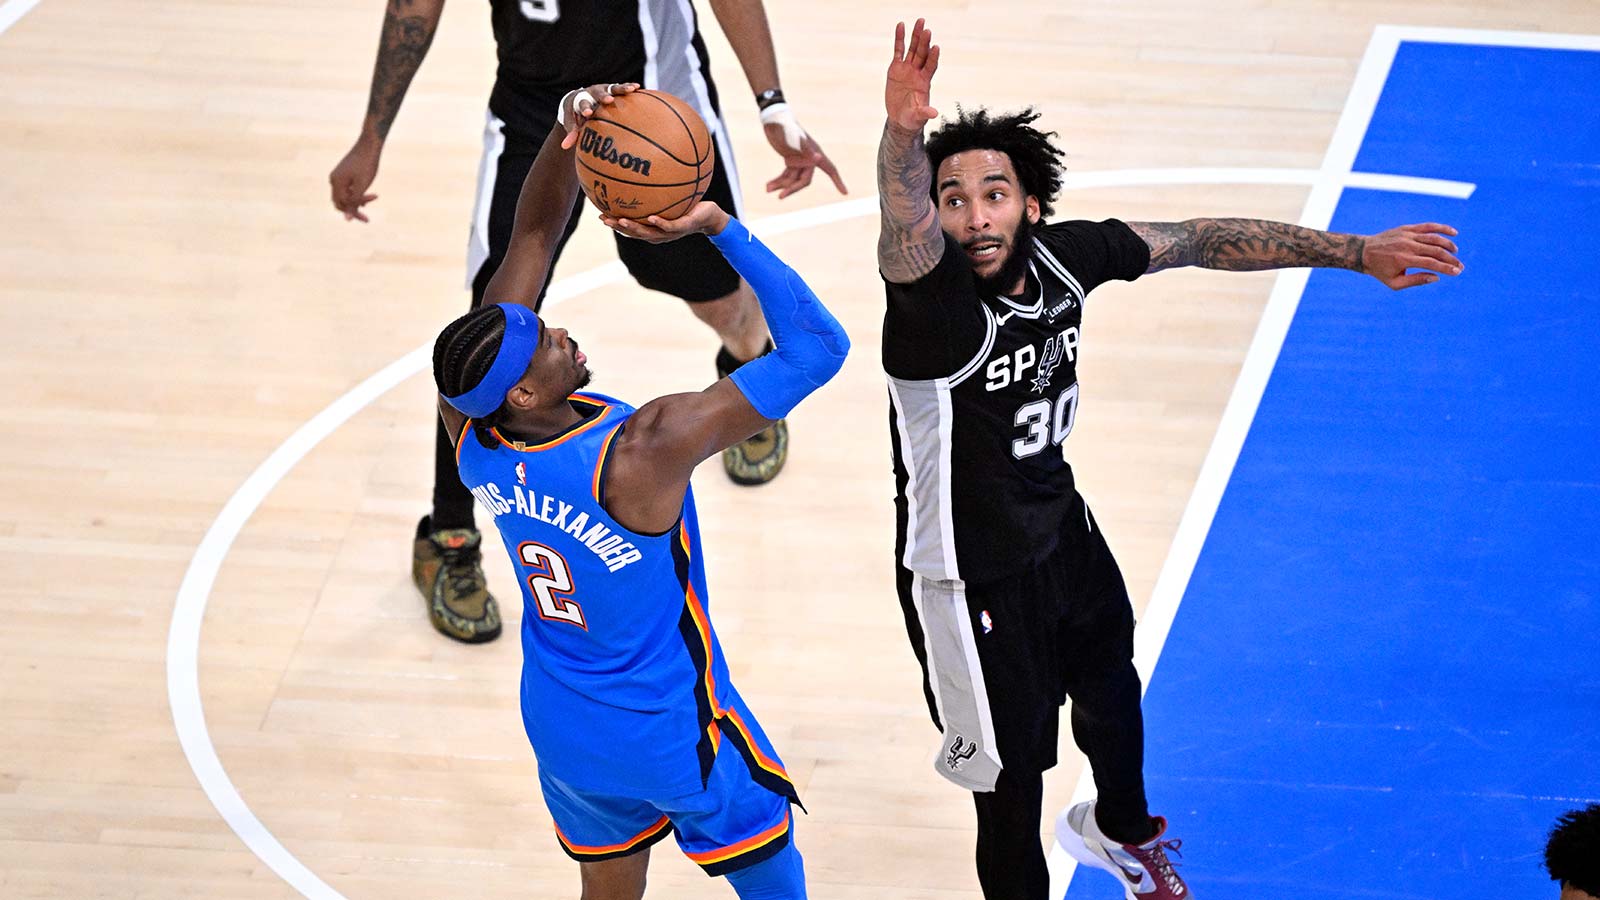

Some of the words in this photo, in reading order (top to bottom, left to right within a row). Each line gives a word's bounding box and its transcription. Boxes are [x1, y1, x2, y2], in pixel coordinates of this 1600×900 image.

[580, 127, 652, 176] Wilson
[1048, 298, 1073, 318] LEDGER
[1012, 382, 1079, 460] 30
[517, 540, 588, 632] 2
